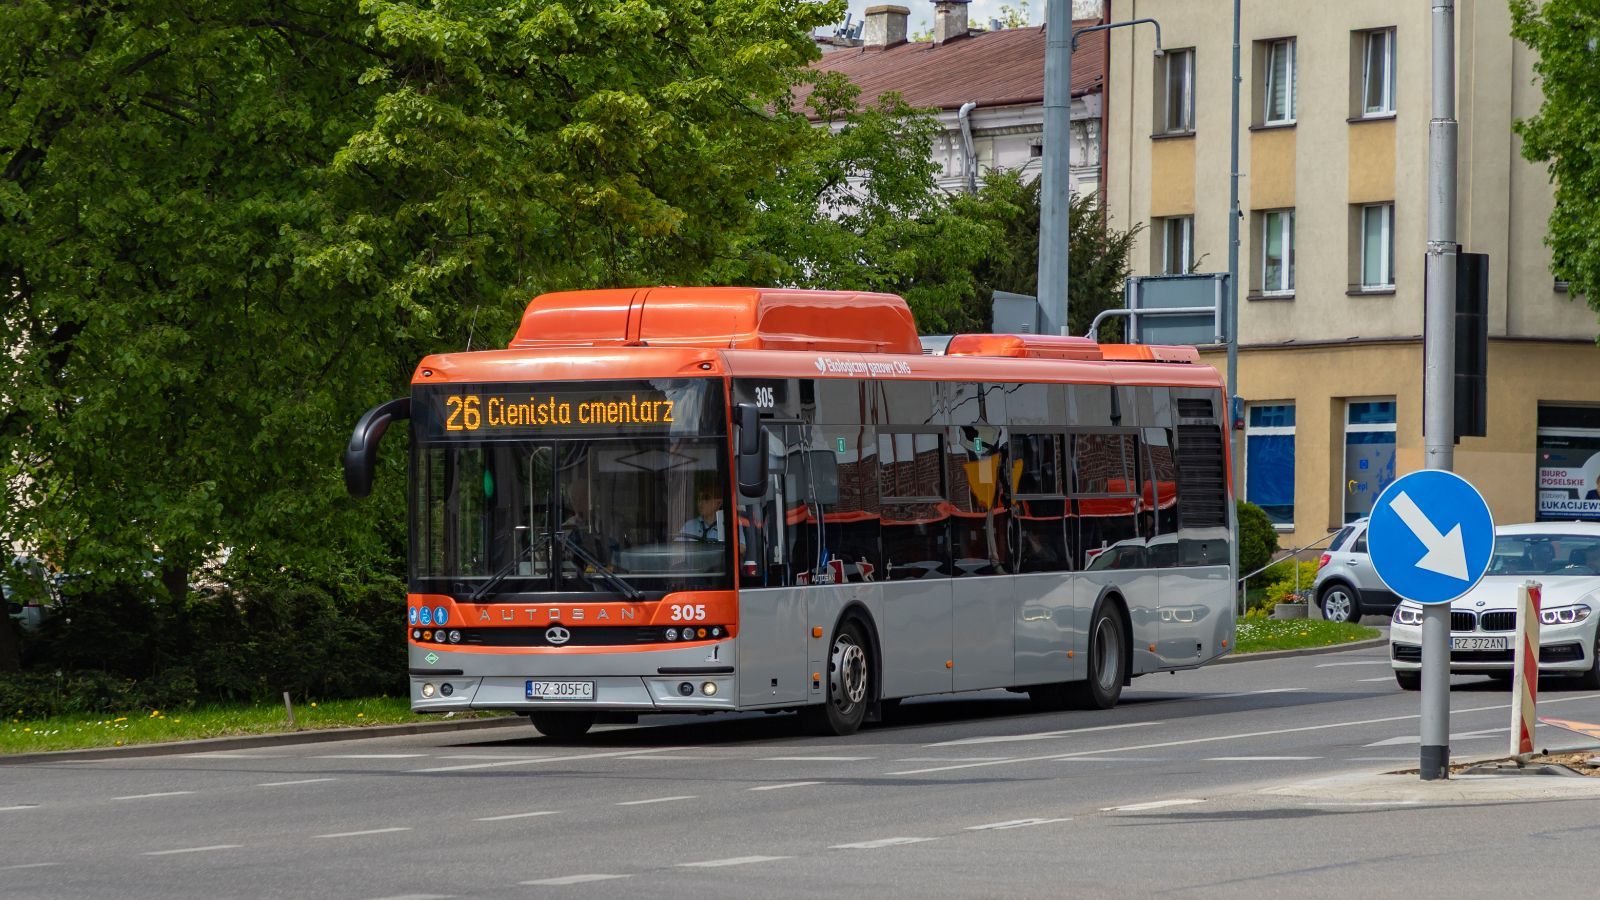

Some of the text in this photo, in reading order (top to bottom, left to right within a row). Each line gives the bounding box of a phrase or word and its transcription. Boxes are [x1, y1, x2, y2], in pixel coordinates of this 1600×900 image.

[825, 357, 911, 377] Ekologiczny gazowy CNG
[755, 387, 774, 408] 305
[446, 394, 675, 430] 26 Cienista cmentarz
[1541, 470, 1567, 478] BIURO
[1541, 478, 1585, 486] POSELSKIE
[1541, 500, 1600, 510] ŁUKACIJEW
[479, 607, 635, 621] AUTOSAN
[670, 604, 706, 621] 305
[1454, 638, 1504, 649] RZ 372AN
[534, 682, 590, 696] RZ 305FC
